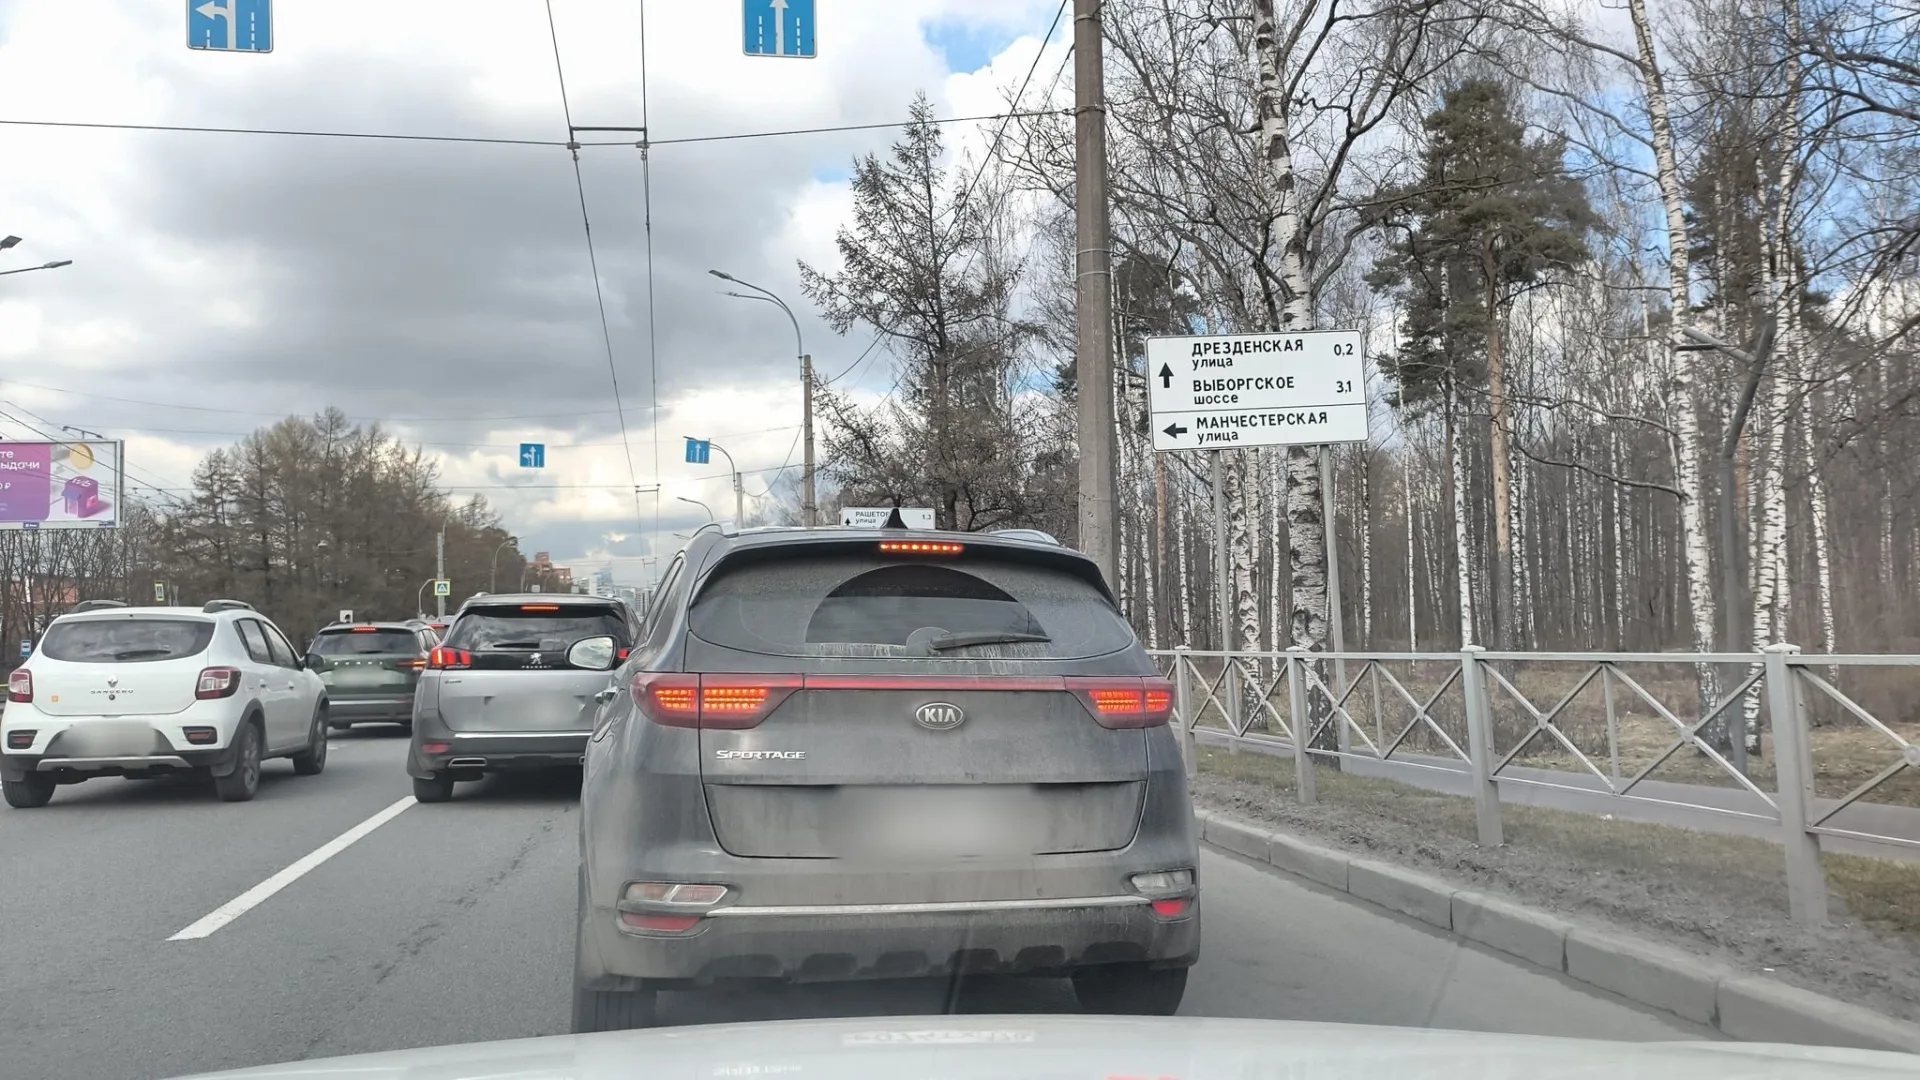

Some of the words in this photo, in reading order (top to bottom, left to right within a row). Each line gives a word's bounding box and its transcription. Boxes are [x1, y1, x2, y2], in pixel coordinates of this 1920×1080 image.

[1191, 339, 1304, 357] ДРЕЗДЕНСКАЯ
[1333, 343, 1354, 357] 0,2
[1192, 356, 1234, 371] улица
[1192, 376, 1295, 392] ВЫБОРГСКОЕ
[1336, 380, 1352, 394] 3,1
[1194, 394, 1239, 405] шоссе
[1196, 411, 1328, 430] МАНЧЕСТЕРСКАЯ
[1197, 431, 1239, 445] улица
[924, 708, 957, 723] KIA
